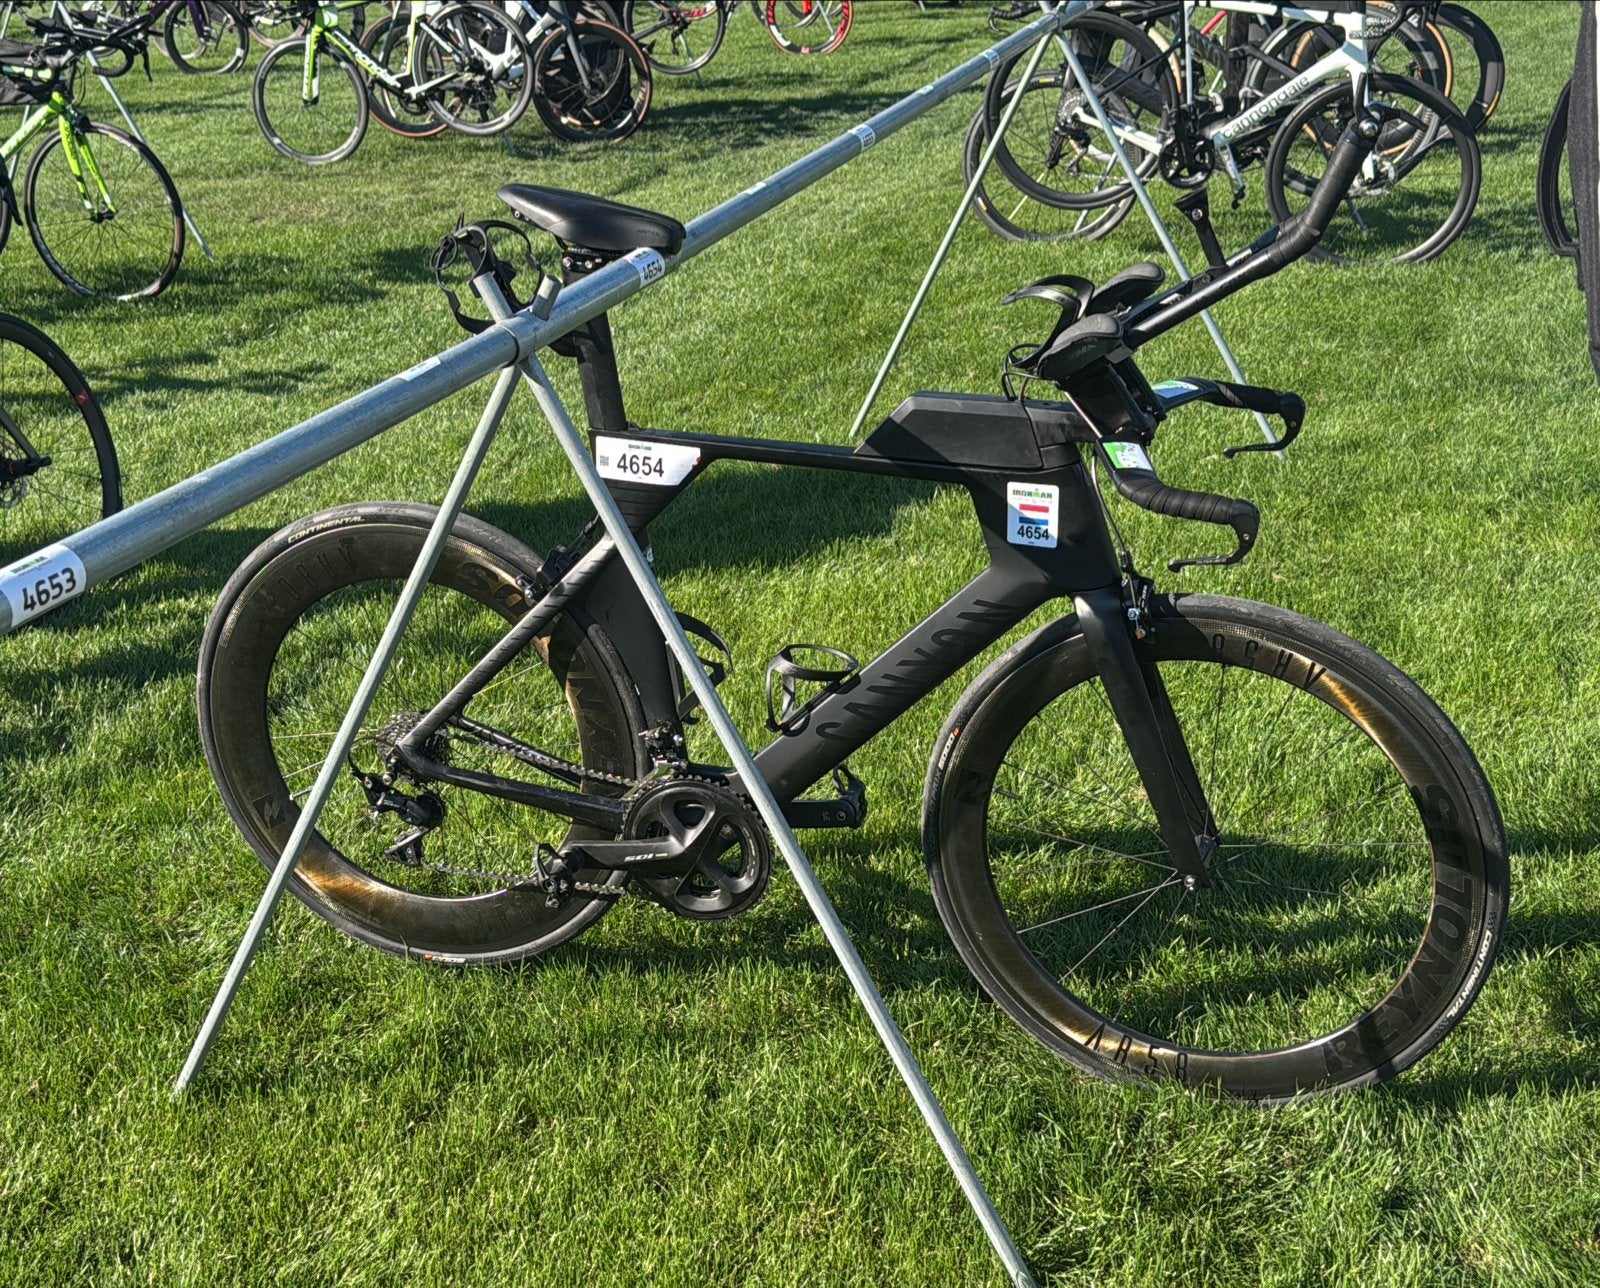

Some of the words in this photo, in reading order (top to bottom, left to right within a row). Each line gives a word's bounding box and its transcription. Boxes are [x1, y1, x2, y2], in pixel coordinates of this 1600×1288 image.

[1222, 76, 1309, 138] cannondale
[642, 259, 662, 280] 4654
[617, 453, 664, 477] 4654
[287, 516, 365, 544] CONTINENTAL
[1017, 525, 1049, 541] 4654
[22, 566, 77, 611] 4653
[815, 598, 1023, 741] CANYON
[1321, 783, 1474, 1075] REYNOLDS
[1446, 929, 1493, 1018] CONTINENTAL
[1083, 1022, 1189, 1088] AR58
